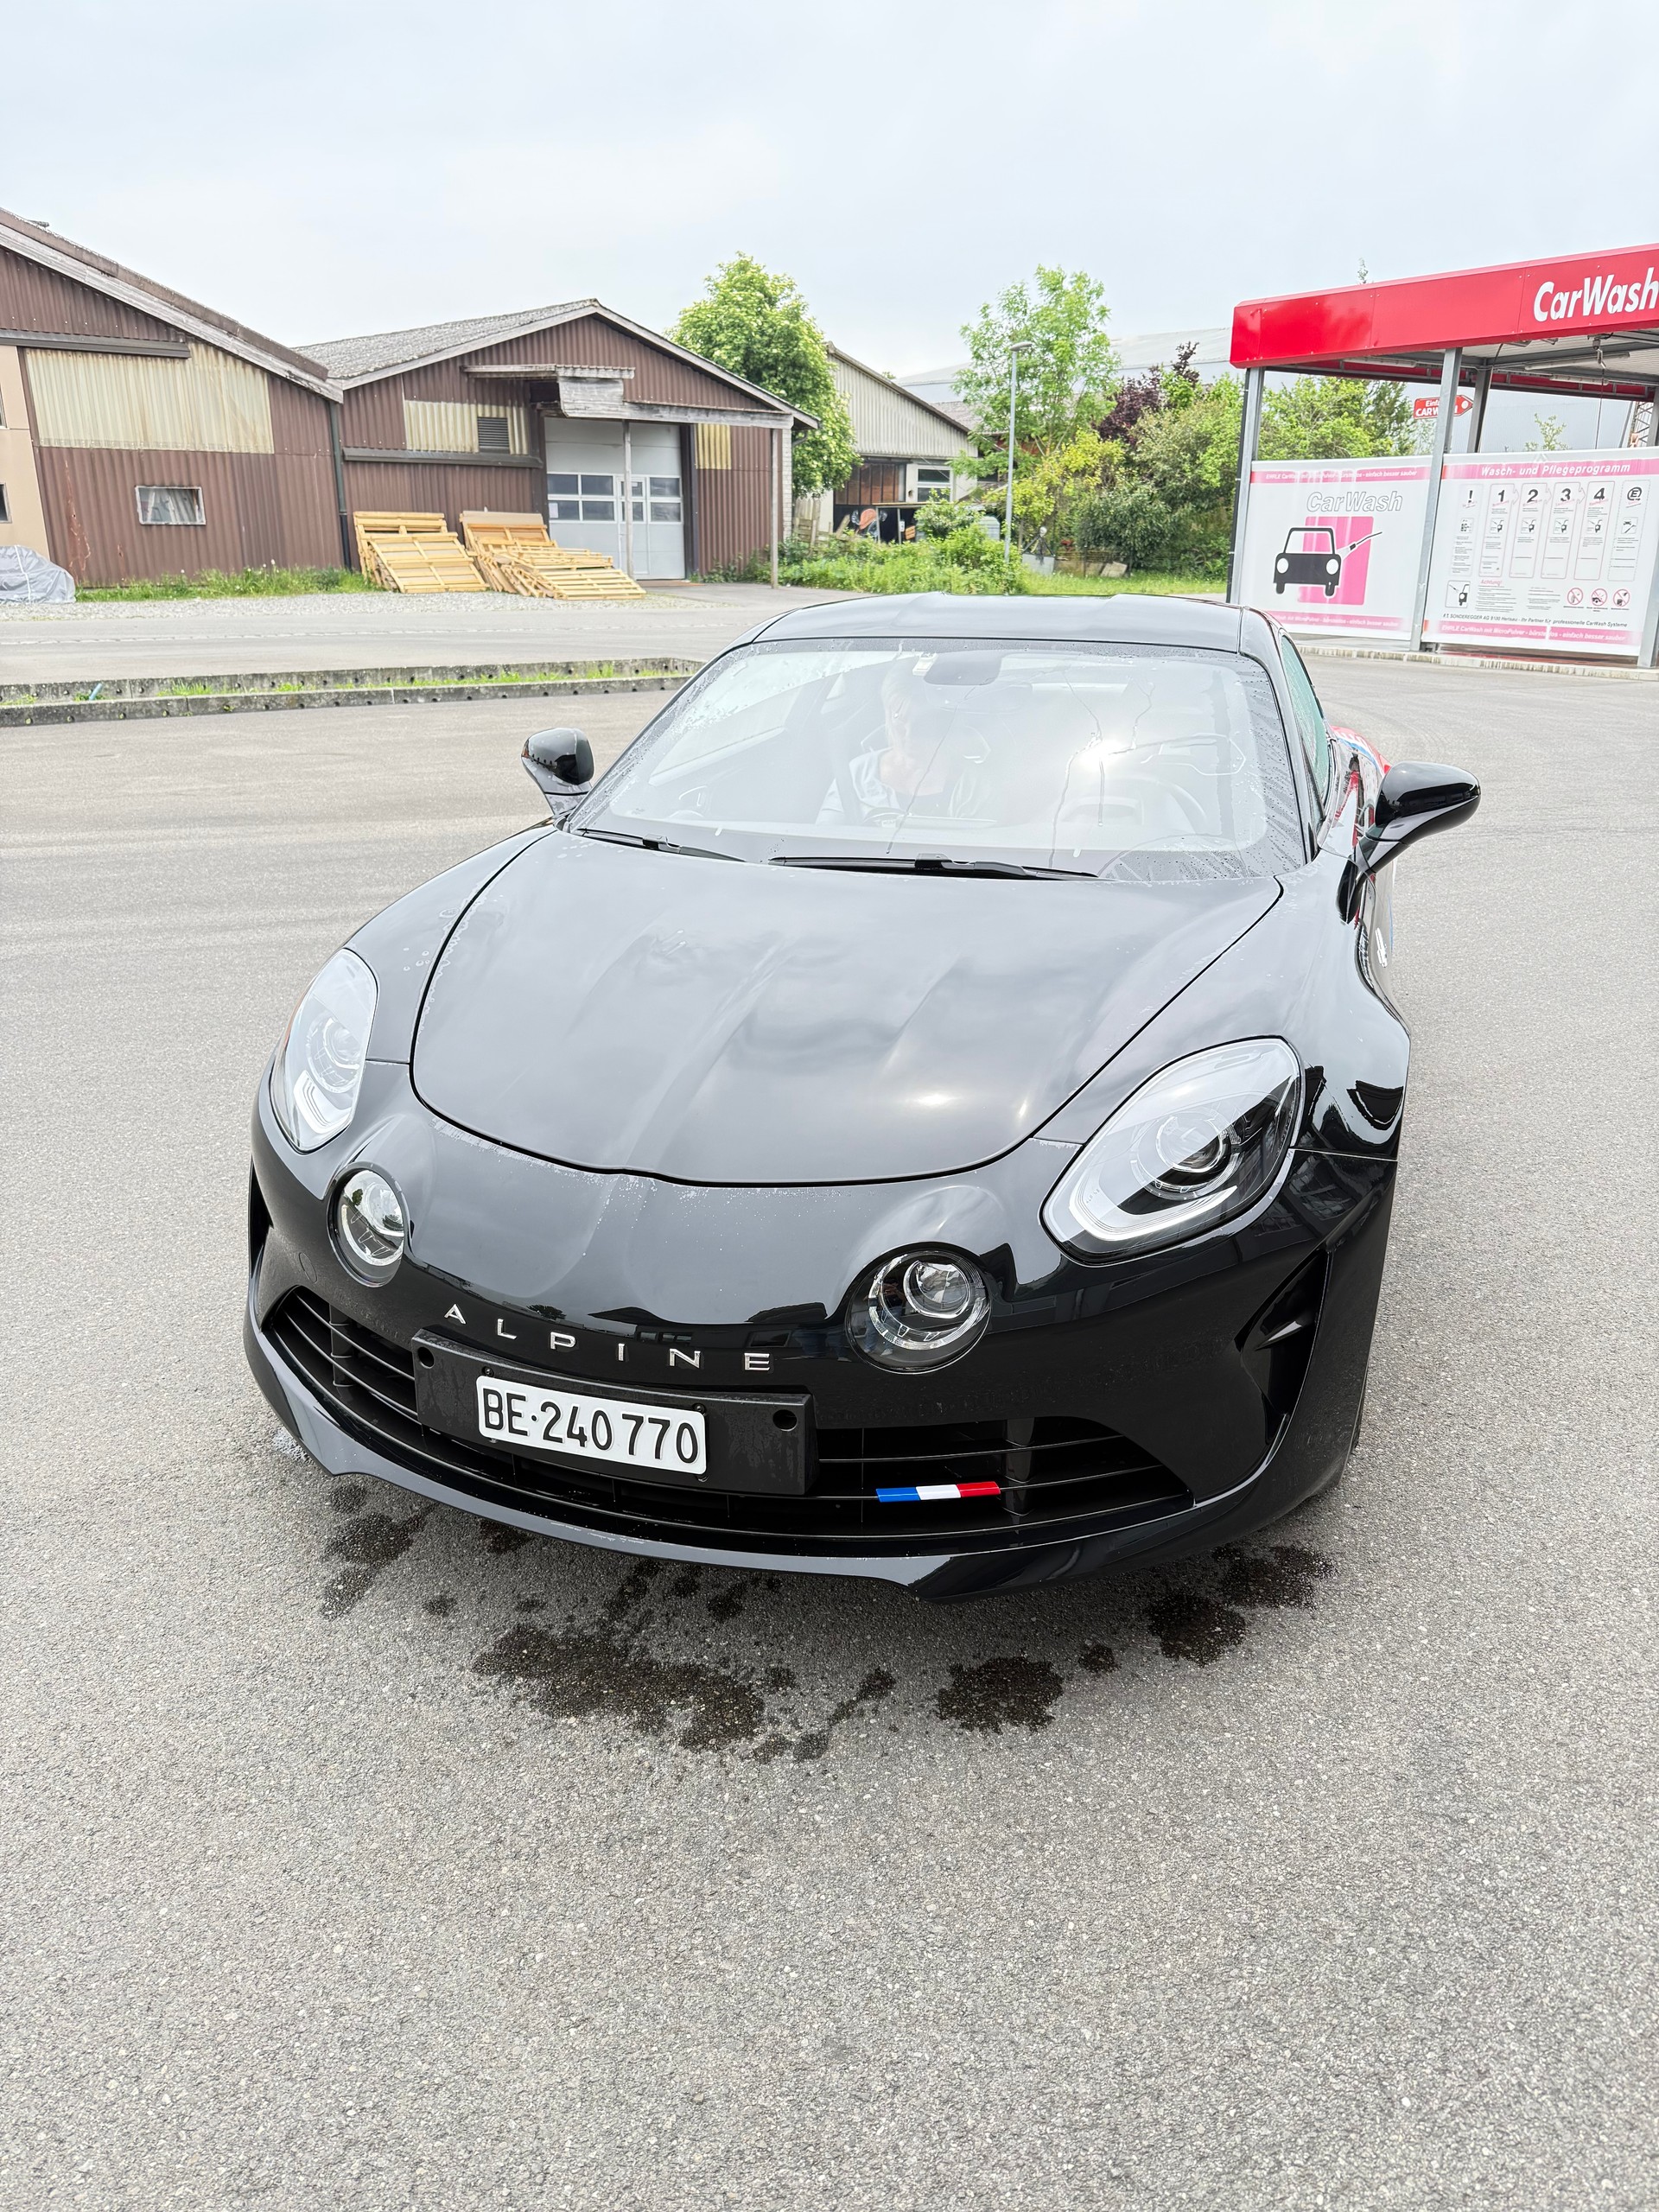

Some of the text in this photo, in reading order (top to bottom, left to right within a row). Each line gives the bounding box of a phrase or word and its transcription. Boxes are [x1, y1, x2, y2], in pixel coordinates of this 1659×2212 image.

[1534, 267, 1659, 322] CarWash
[1481, 463, 1631, 476] Wasch- und Pflegeprogramm
[1497, 489, 1505, 502] 1
[1527, 489, 1538, 503] 2
[1560, 488, 1571, 501] 3
[1593, 487, 1605, 500] 4
[1306, 491, 1403, 512] CarWash
[444, 1303, 771, 1371] ALPINE
